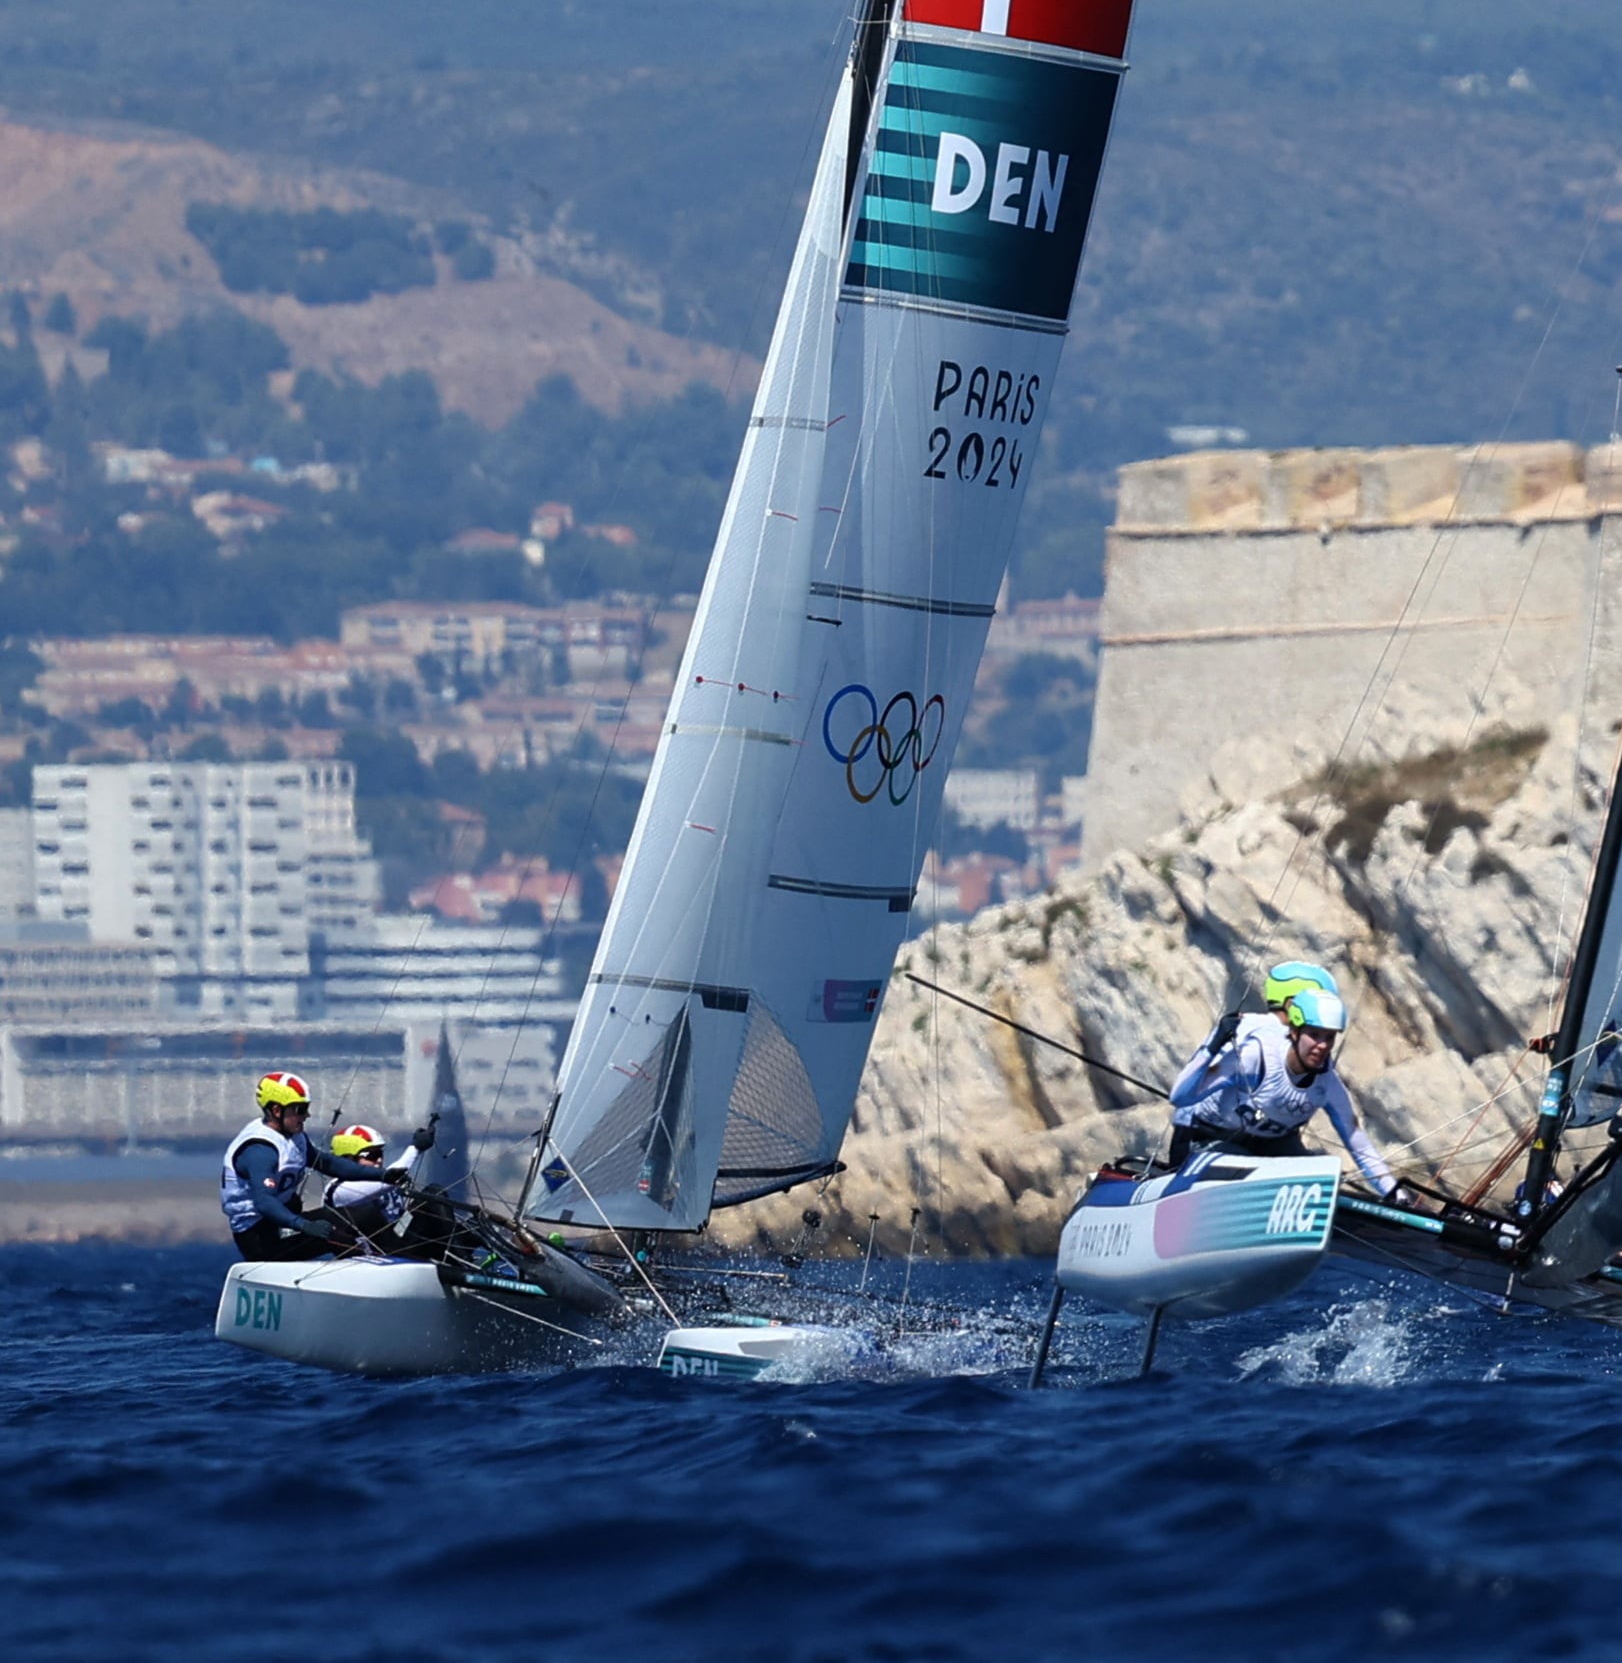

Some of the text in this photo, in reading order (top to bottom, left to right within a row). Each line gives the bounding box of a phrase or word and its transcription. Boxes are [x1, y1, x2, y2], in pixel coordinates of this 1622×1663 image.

[931, 132, 1069, 233] DEN
[924, 426, 1022, 489] 2024
[1266, 1183, 1321, 1234] ARG
[234, 1287, 282, 1332] DEN
